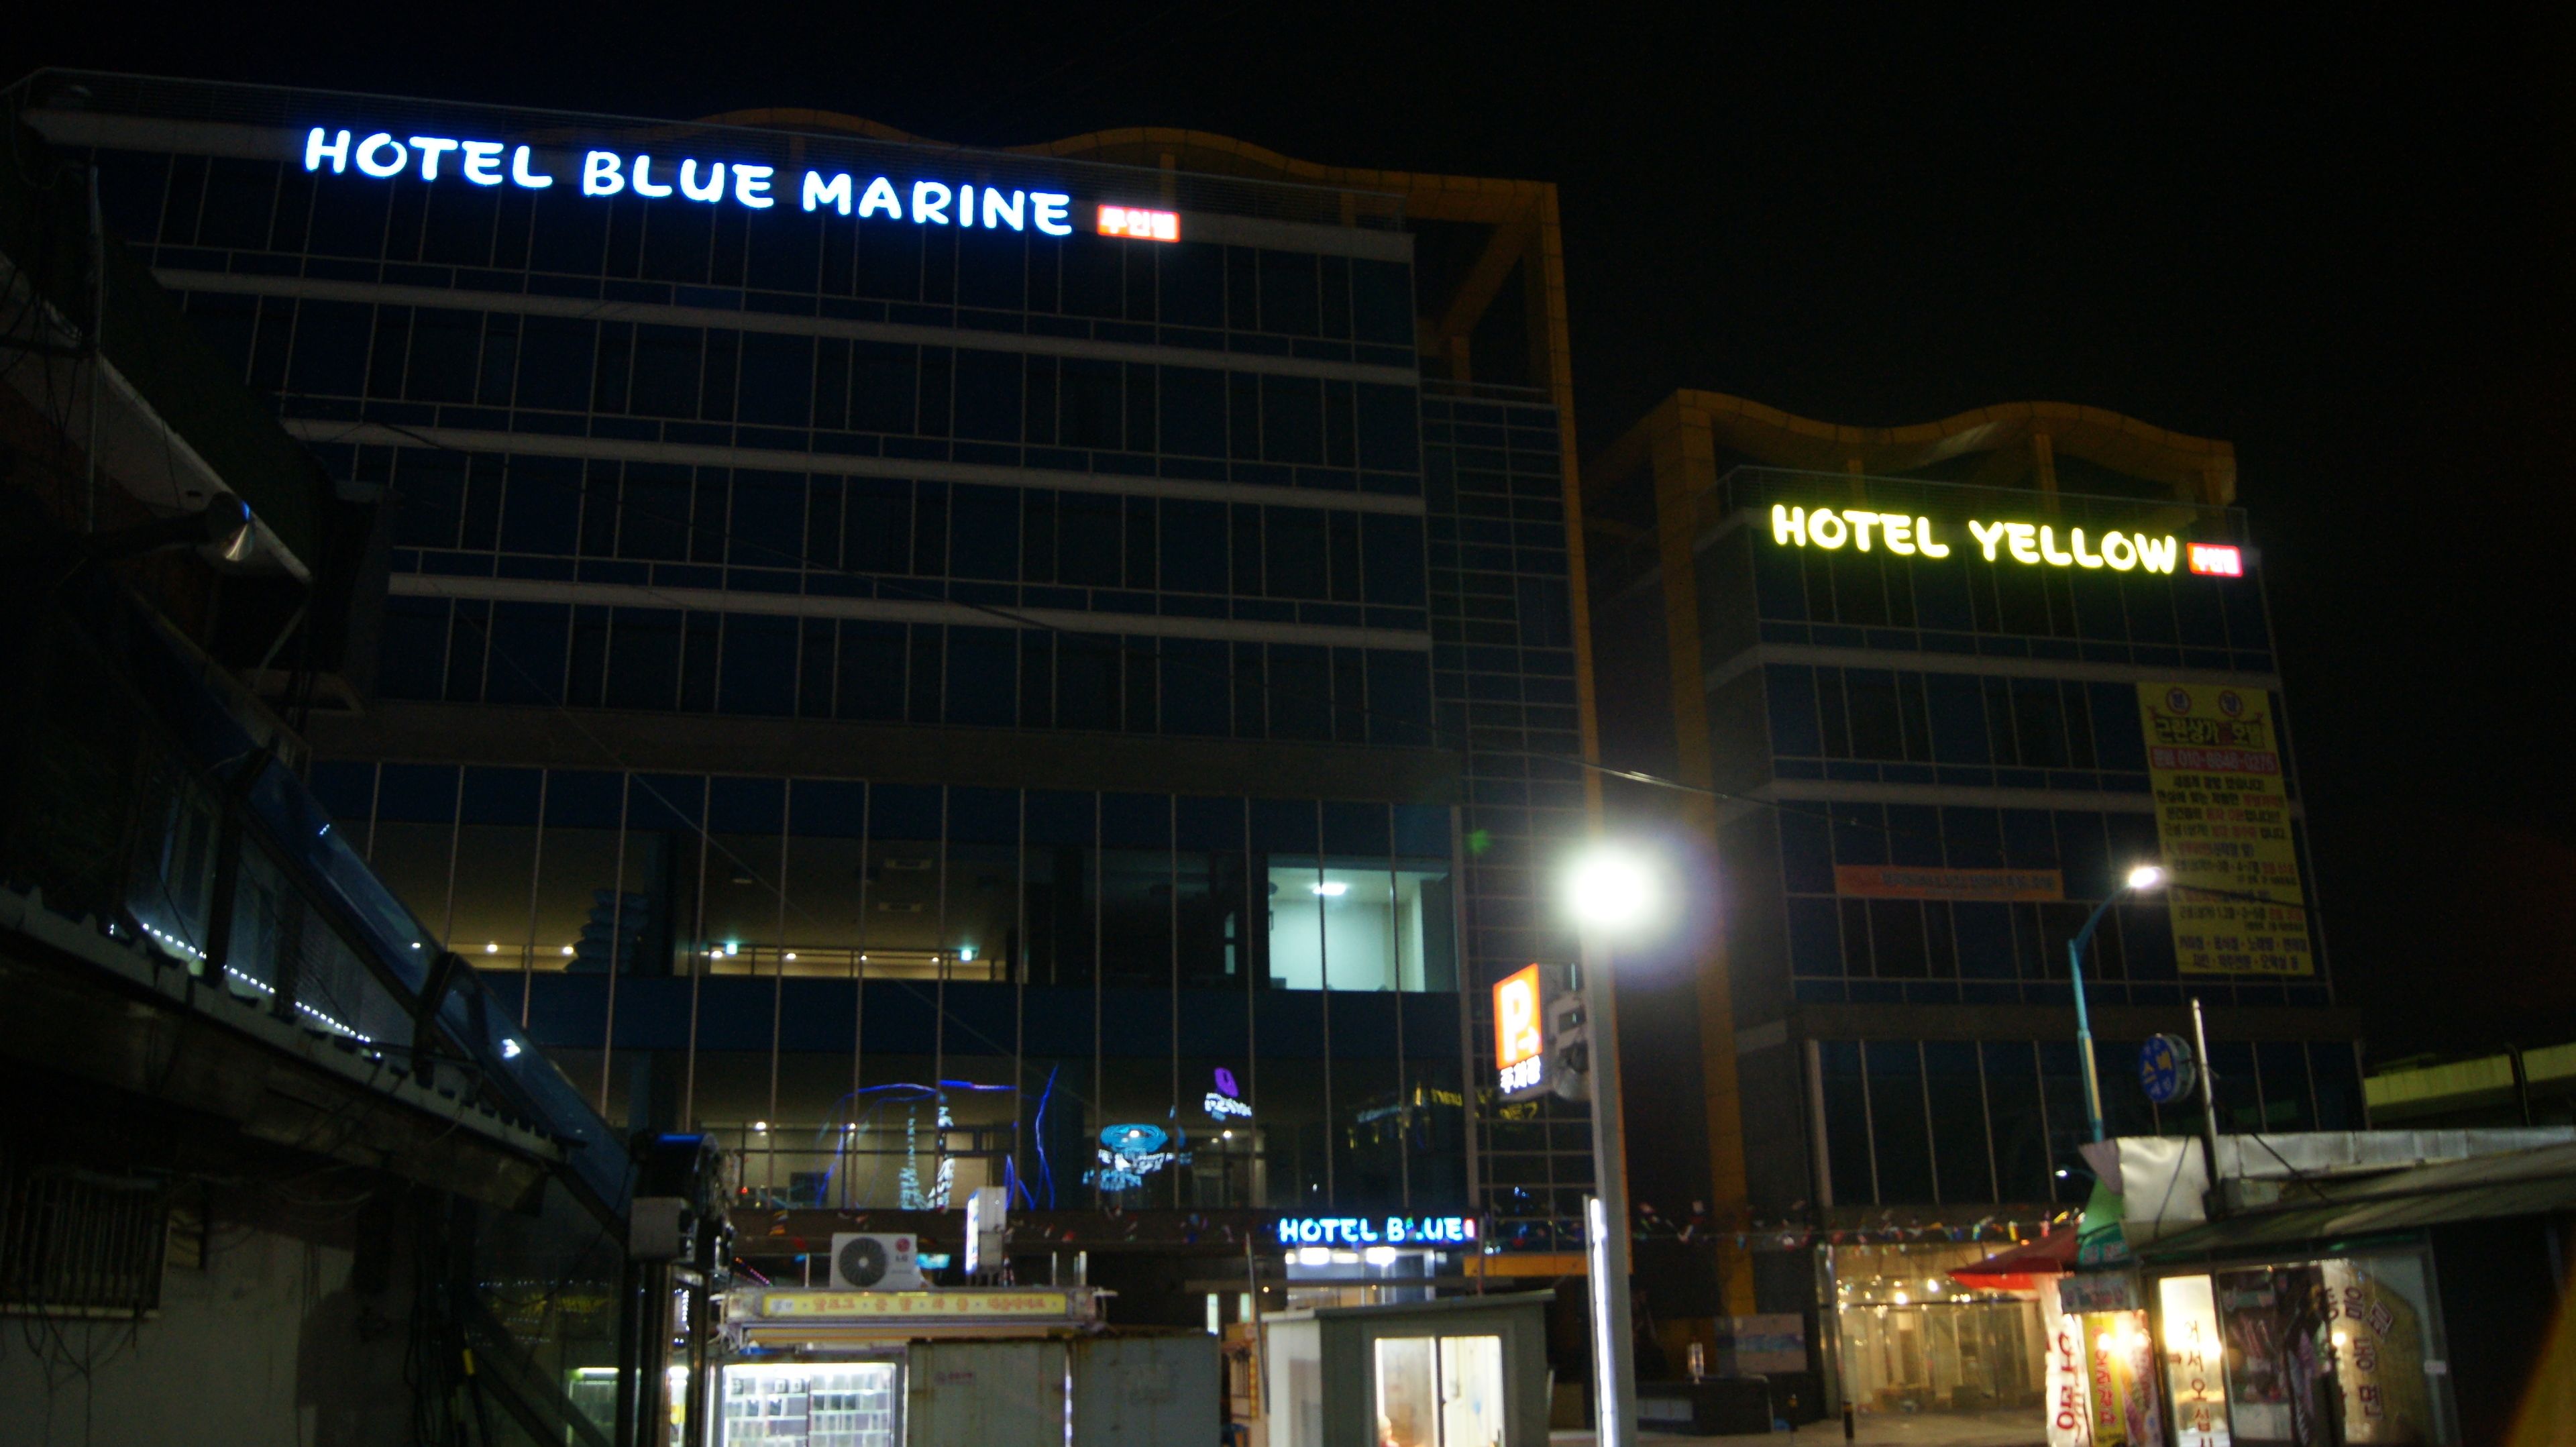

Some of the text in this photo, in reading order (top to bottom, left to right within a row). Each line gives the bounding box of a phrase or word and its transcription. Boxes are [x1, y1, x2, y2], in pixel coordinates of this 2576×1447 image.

[305, 127, 1073, 236] HOTEL BLUE MARINE
[1771, 504, 2178, 575] HOTEL YELLOW
[1501, 979, 1532, 1062] P
[1279, 1218, 1379, 1244] HOTEL
